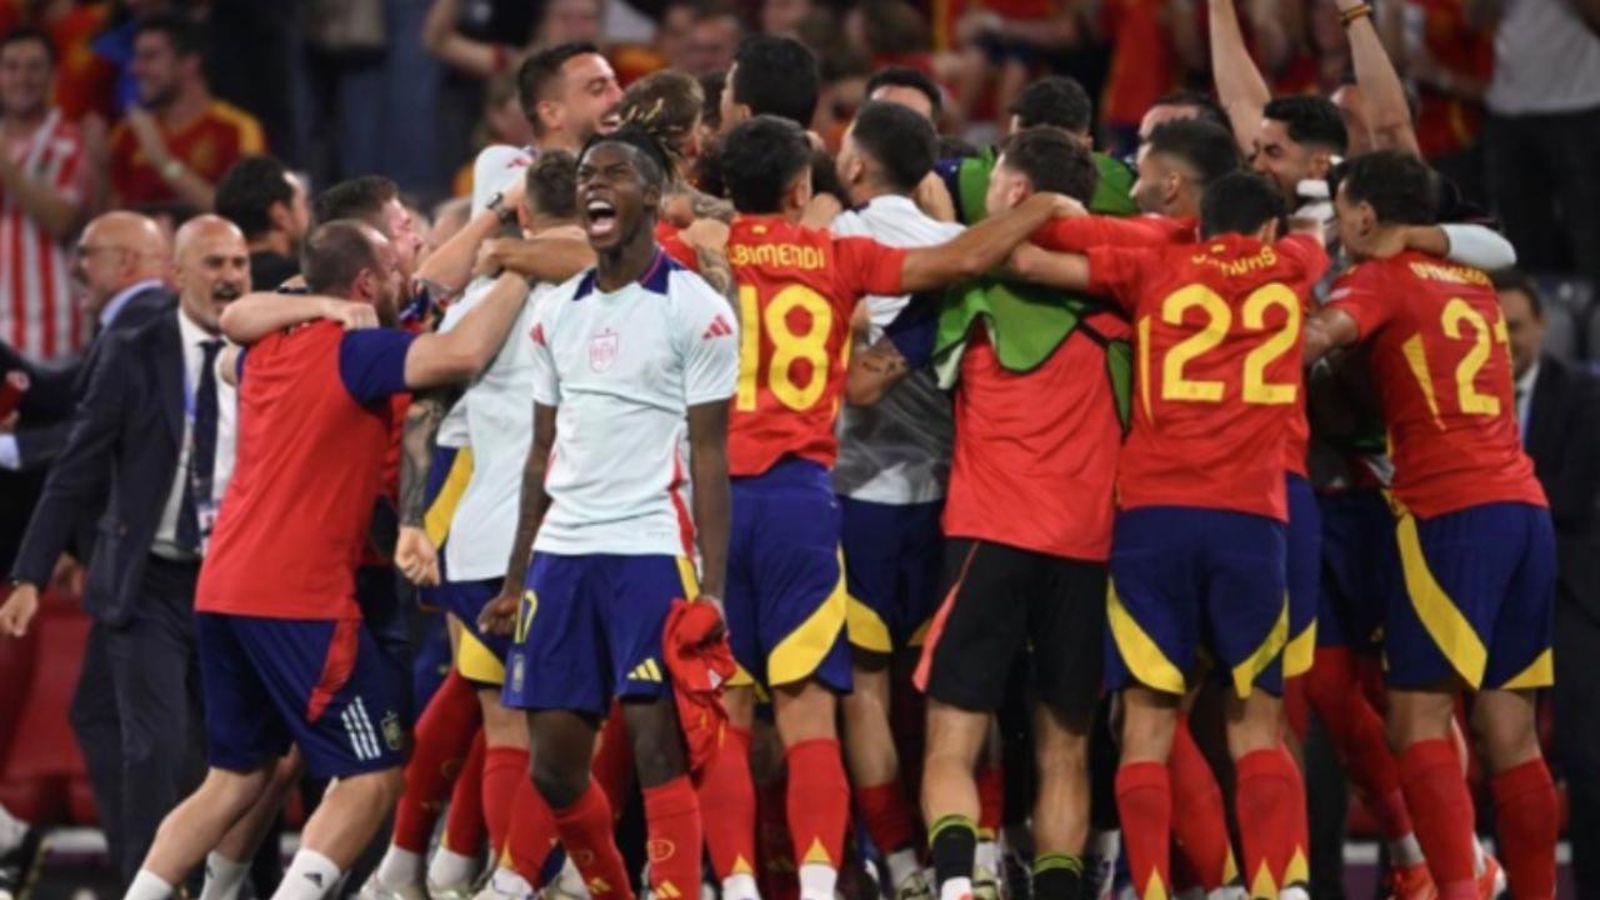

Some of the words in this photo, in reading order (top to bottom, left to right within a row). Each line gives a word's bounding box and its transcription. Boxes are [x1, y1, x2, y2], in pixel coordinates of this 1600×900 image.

[730, 243, 825, 269] BIMENDI
[736, 283, 832, 411] 18
[1162, 282, 1300, 404] 22
